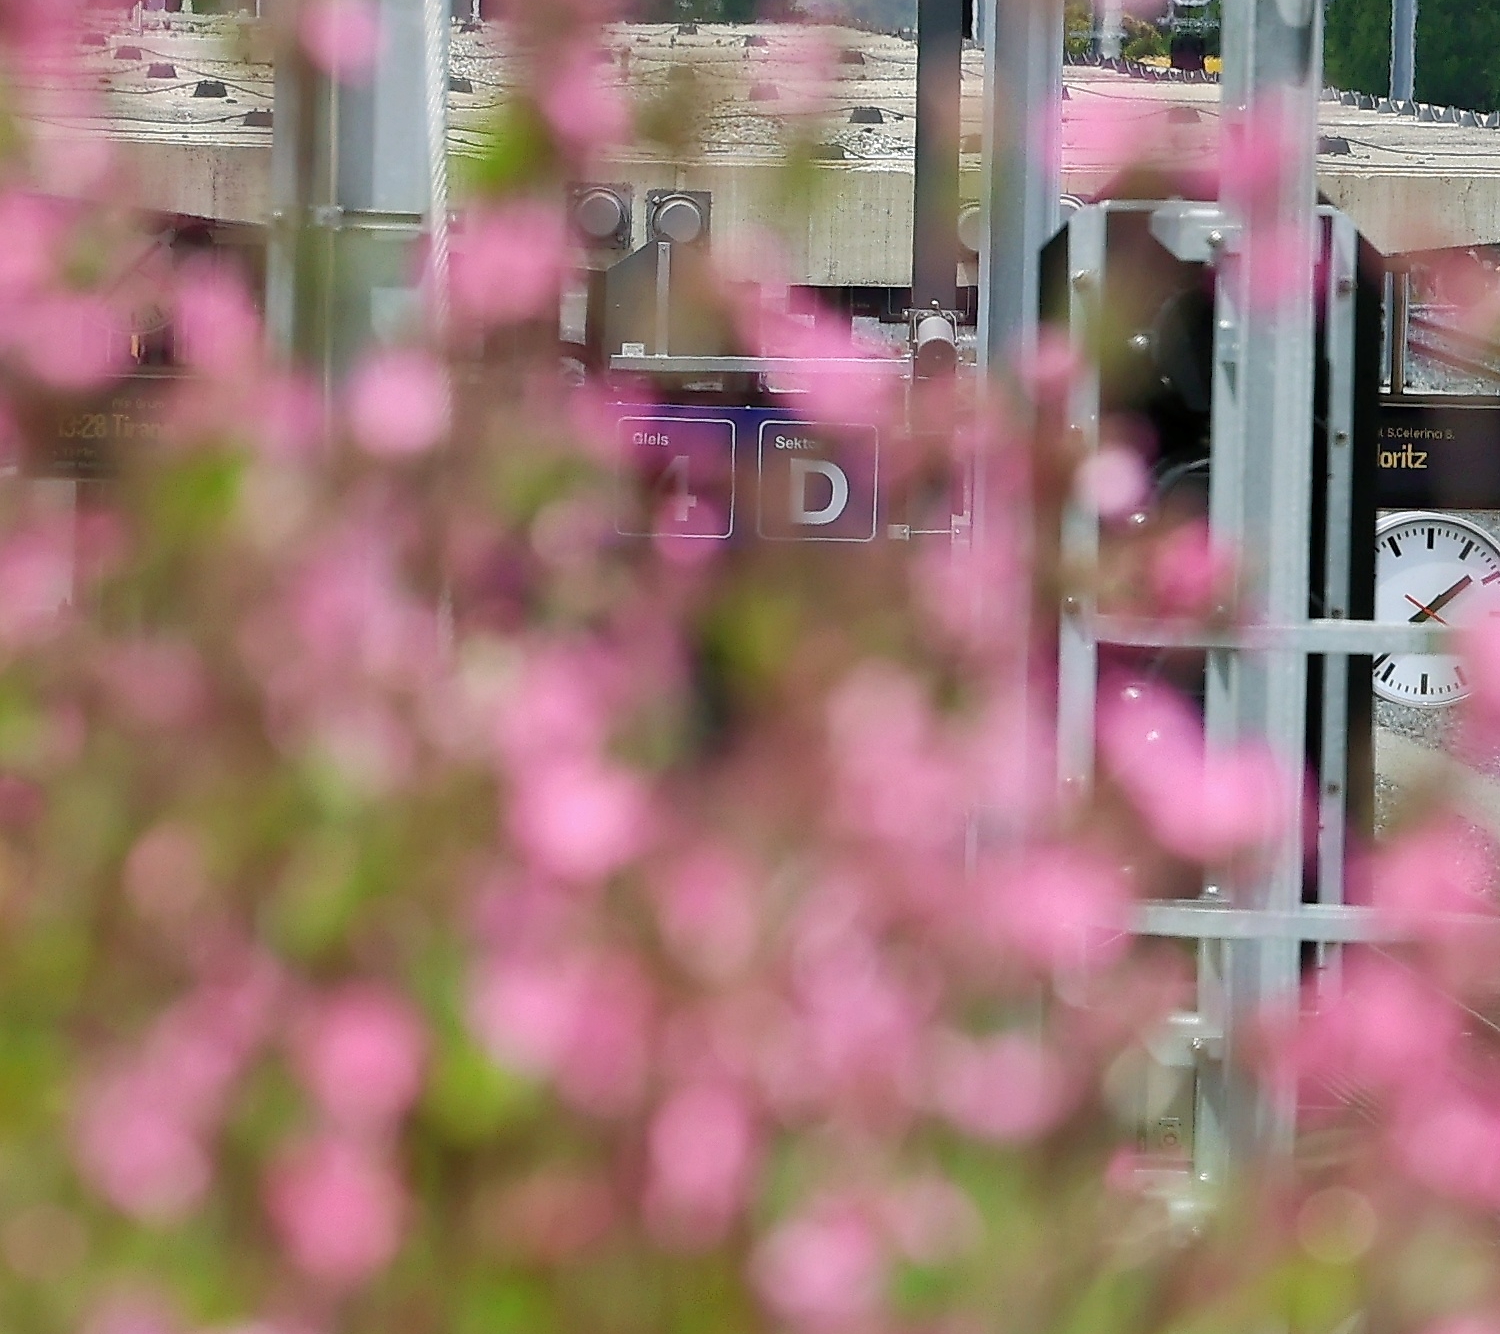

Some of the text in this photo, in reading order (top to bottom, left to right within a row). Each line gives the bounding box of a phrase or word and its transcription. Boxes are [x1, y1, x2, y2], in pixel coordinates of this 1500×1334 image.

[632, 432, 670, 447] Gleis
[1377, 443, 1428, 469] oritz
[789, 457, 849, 526] D
